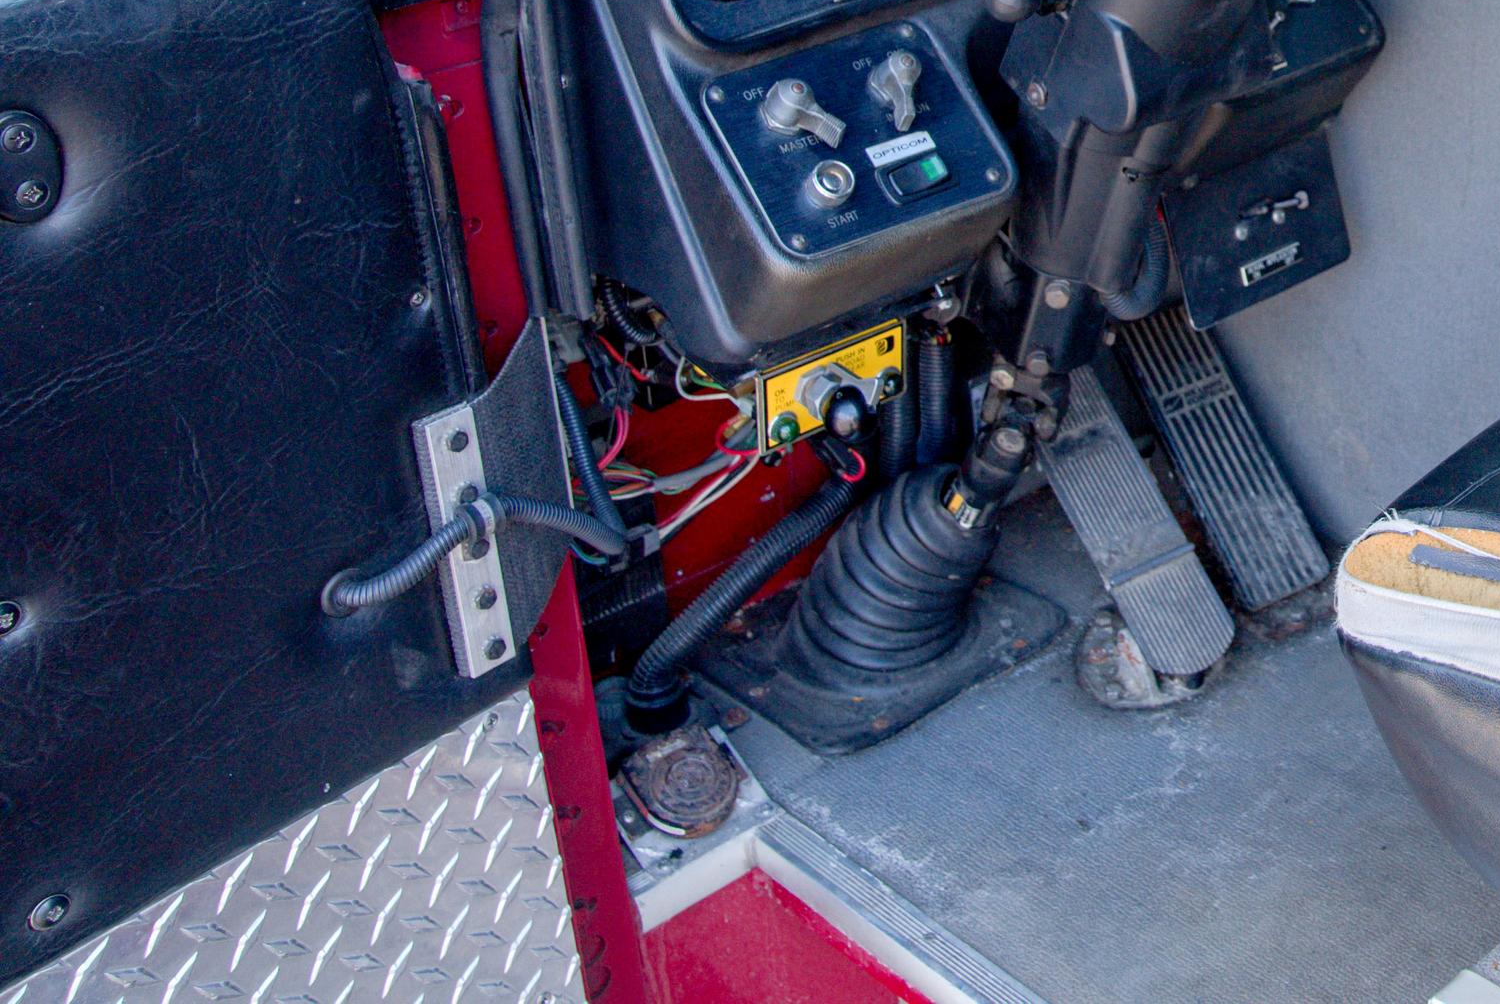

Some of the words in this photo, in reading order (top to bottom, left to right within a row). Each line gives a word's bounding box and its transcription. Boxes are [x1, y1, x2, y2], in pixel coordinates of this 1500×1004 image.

[852, 56, 873, 71] OFF
[742, 86, 765, 101] OFF
[872, 136, 928, 160] OPTICOM
[826, 209, 860, 229] START
[774, 389, 786, 398] OK
